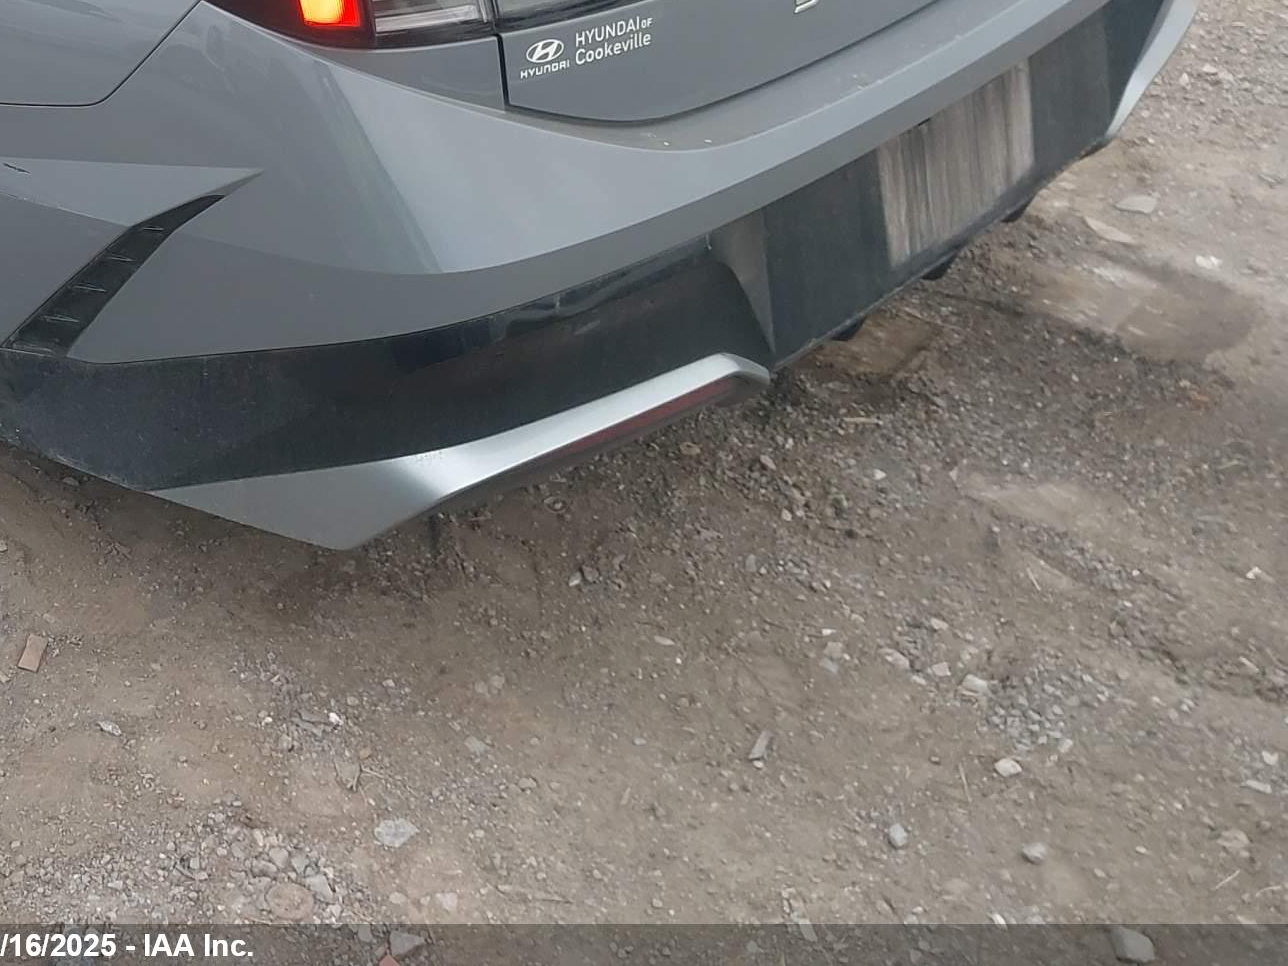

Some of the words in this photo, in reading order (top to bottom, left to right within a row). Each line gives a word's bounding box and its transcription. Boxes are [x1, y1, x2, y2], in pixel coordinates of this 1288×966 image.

[574, 15, 640, 48] HYUNDAI
[640, 17, 654, 30] OF
[574, 32, 652, 66] Cookeville
[519, 59, 571, 80] HYUNDAI
